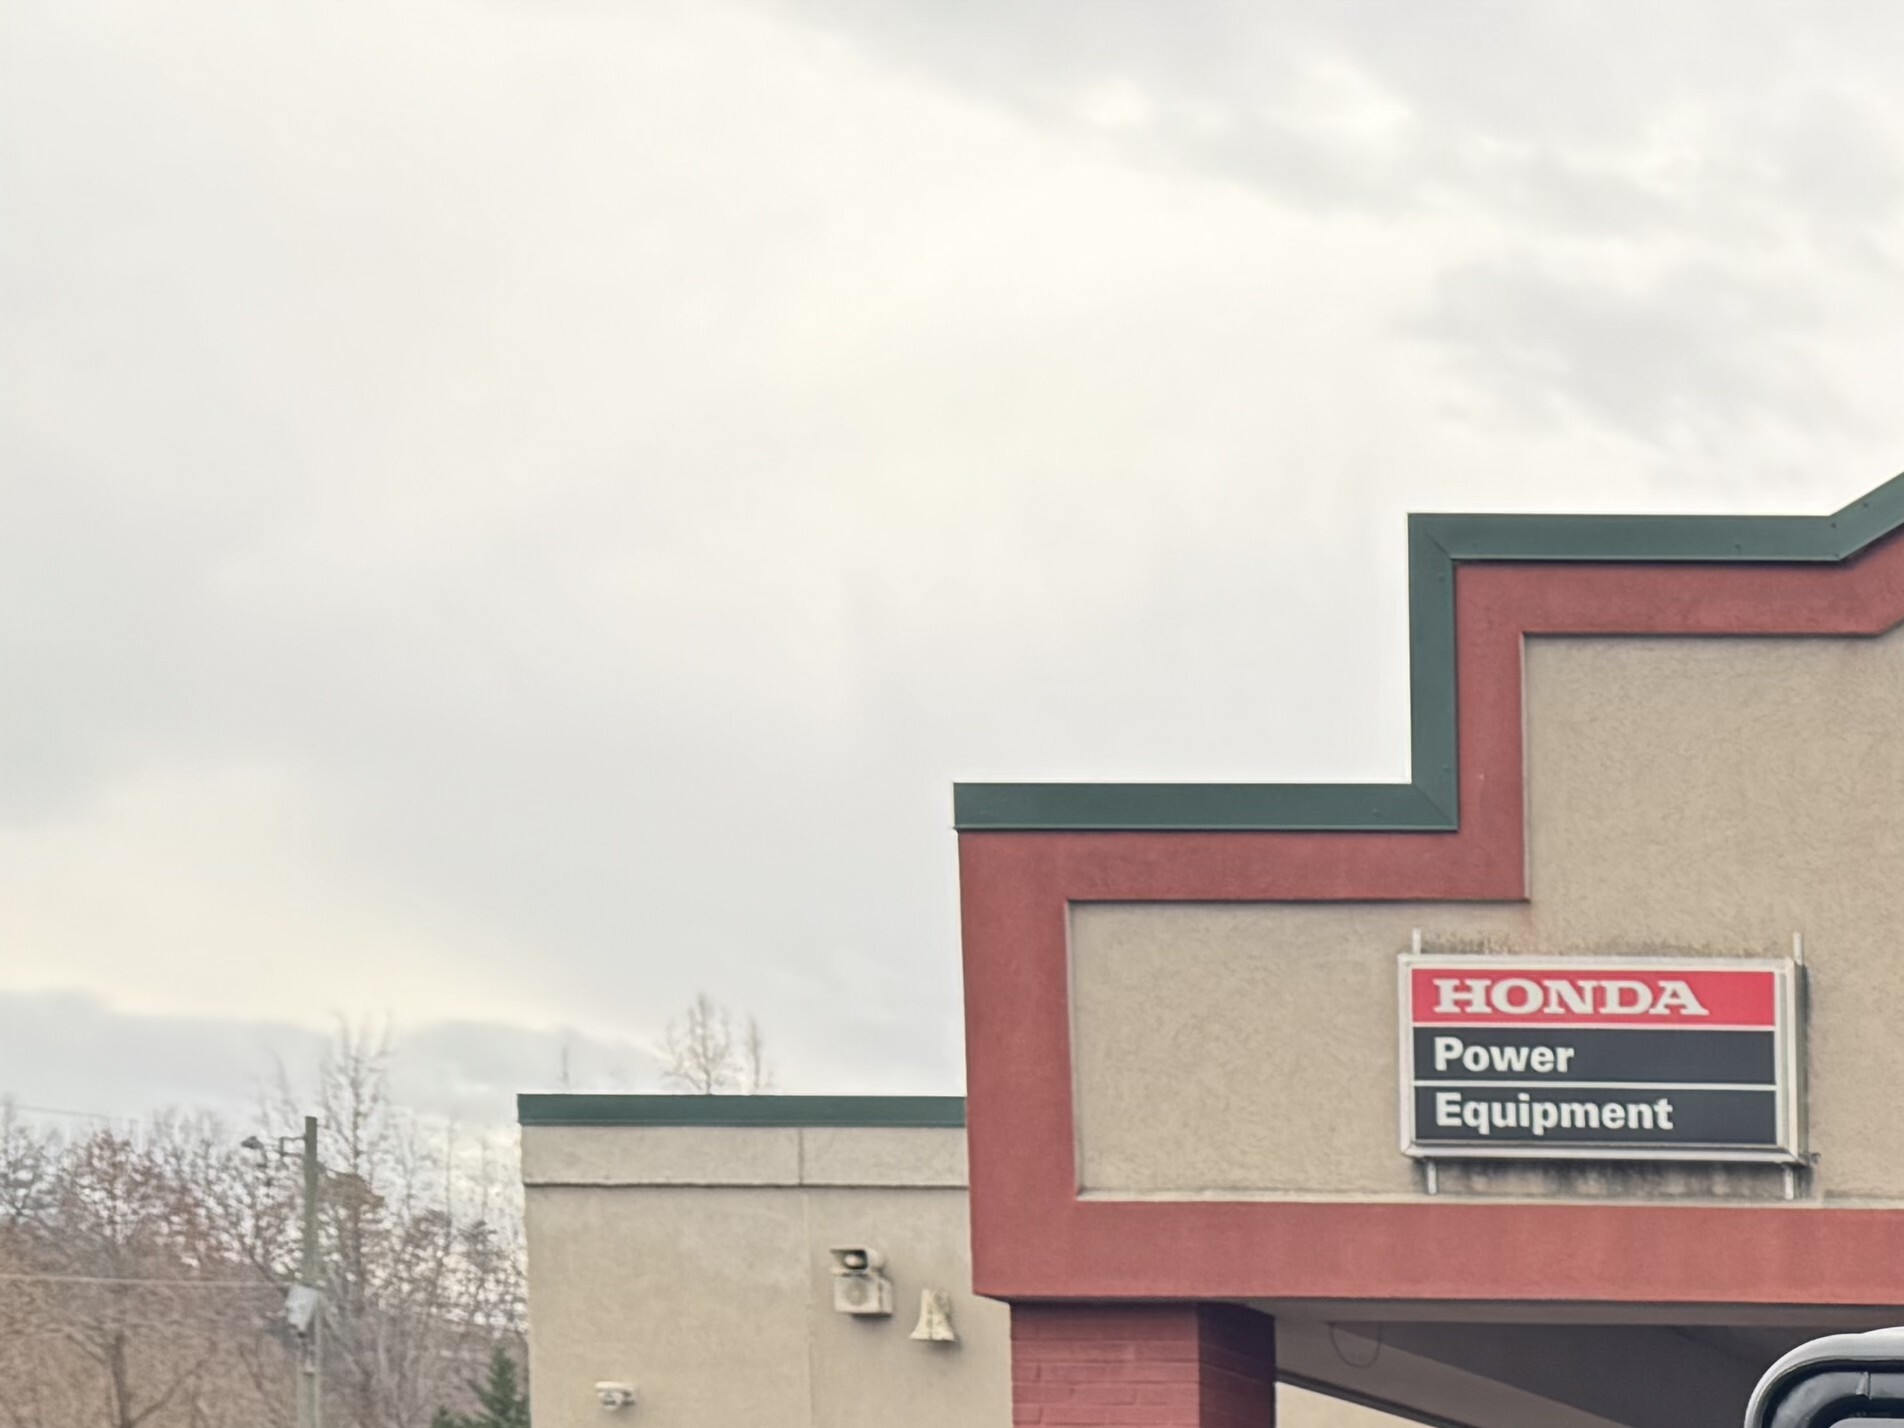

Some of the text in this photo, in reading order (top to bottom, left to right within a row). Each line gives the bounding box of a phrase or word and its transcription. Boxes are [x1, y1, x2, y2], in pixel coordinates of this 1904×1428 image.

[1433, 978, 1709, 1016] HONDA
[1434, 1036, 1575, 1073] Power
[1435, 1092, 1674, 1136] Equipment
